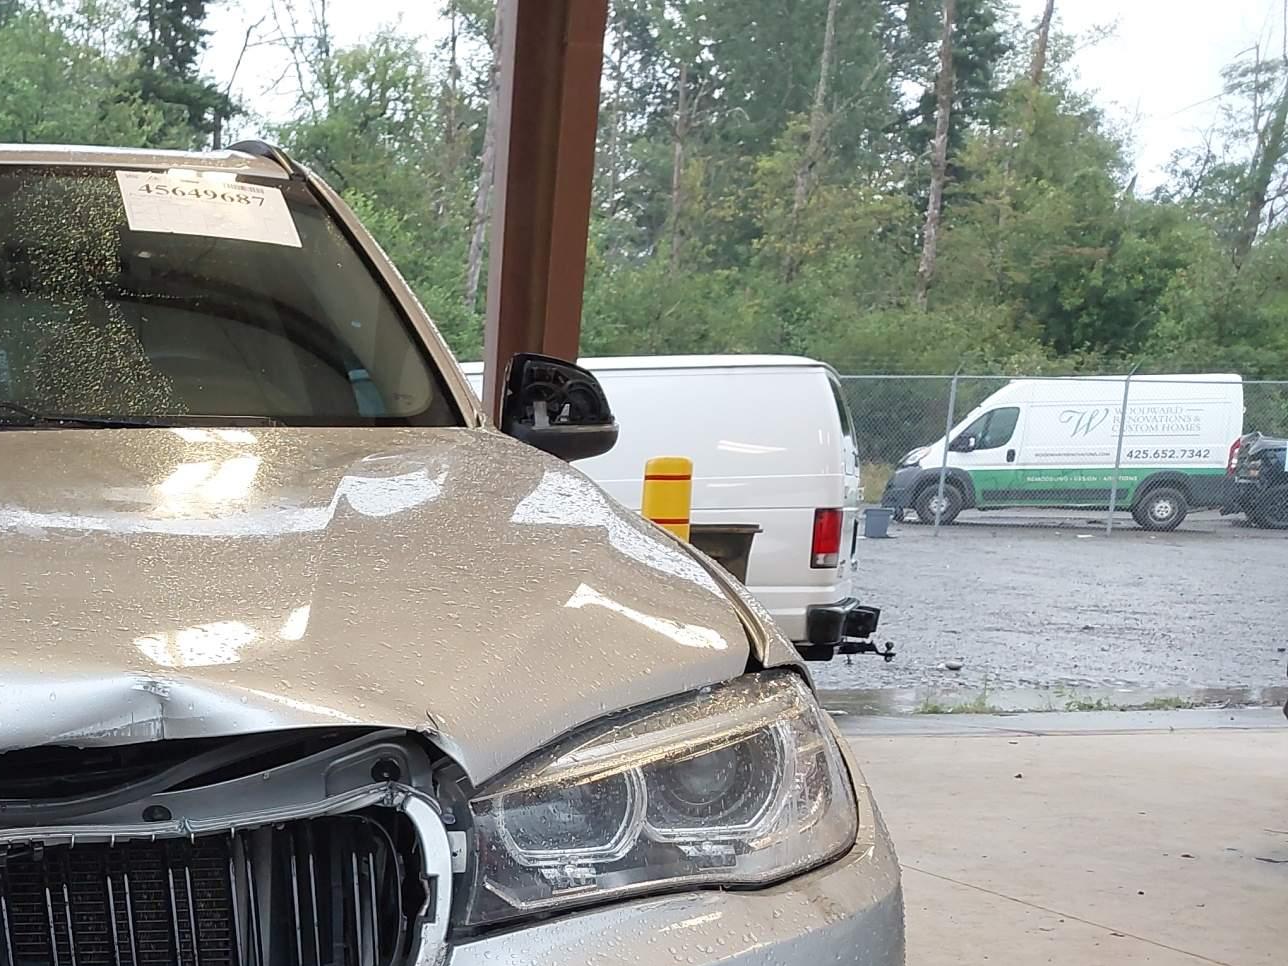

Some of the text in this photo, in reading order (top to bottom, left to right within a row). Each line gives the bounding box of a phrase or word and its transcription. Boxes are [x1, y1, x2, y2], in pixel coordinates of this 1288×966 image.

[138, 183, 265, 207] 45649687
[1114, 407, 1184, 415] WODWARD
[1113, 415, 1192, 424] RNOVATIONS
[1112, 423, 1201, 433] CSTOM HOMES
[1126, 448, 1210, 459] 425.652.7342
